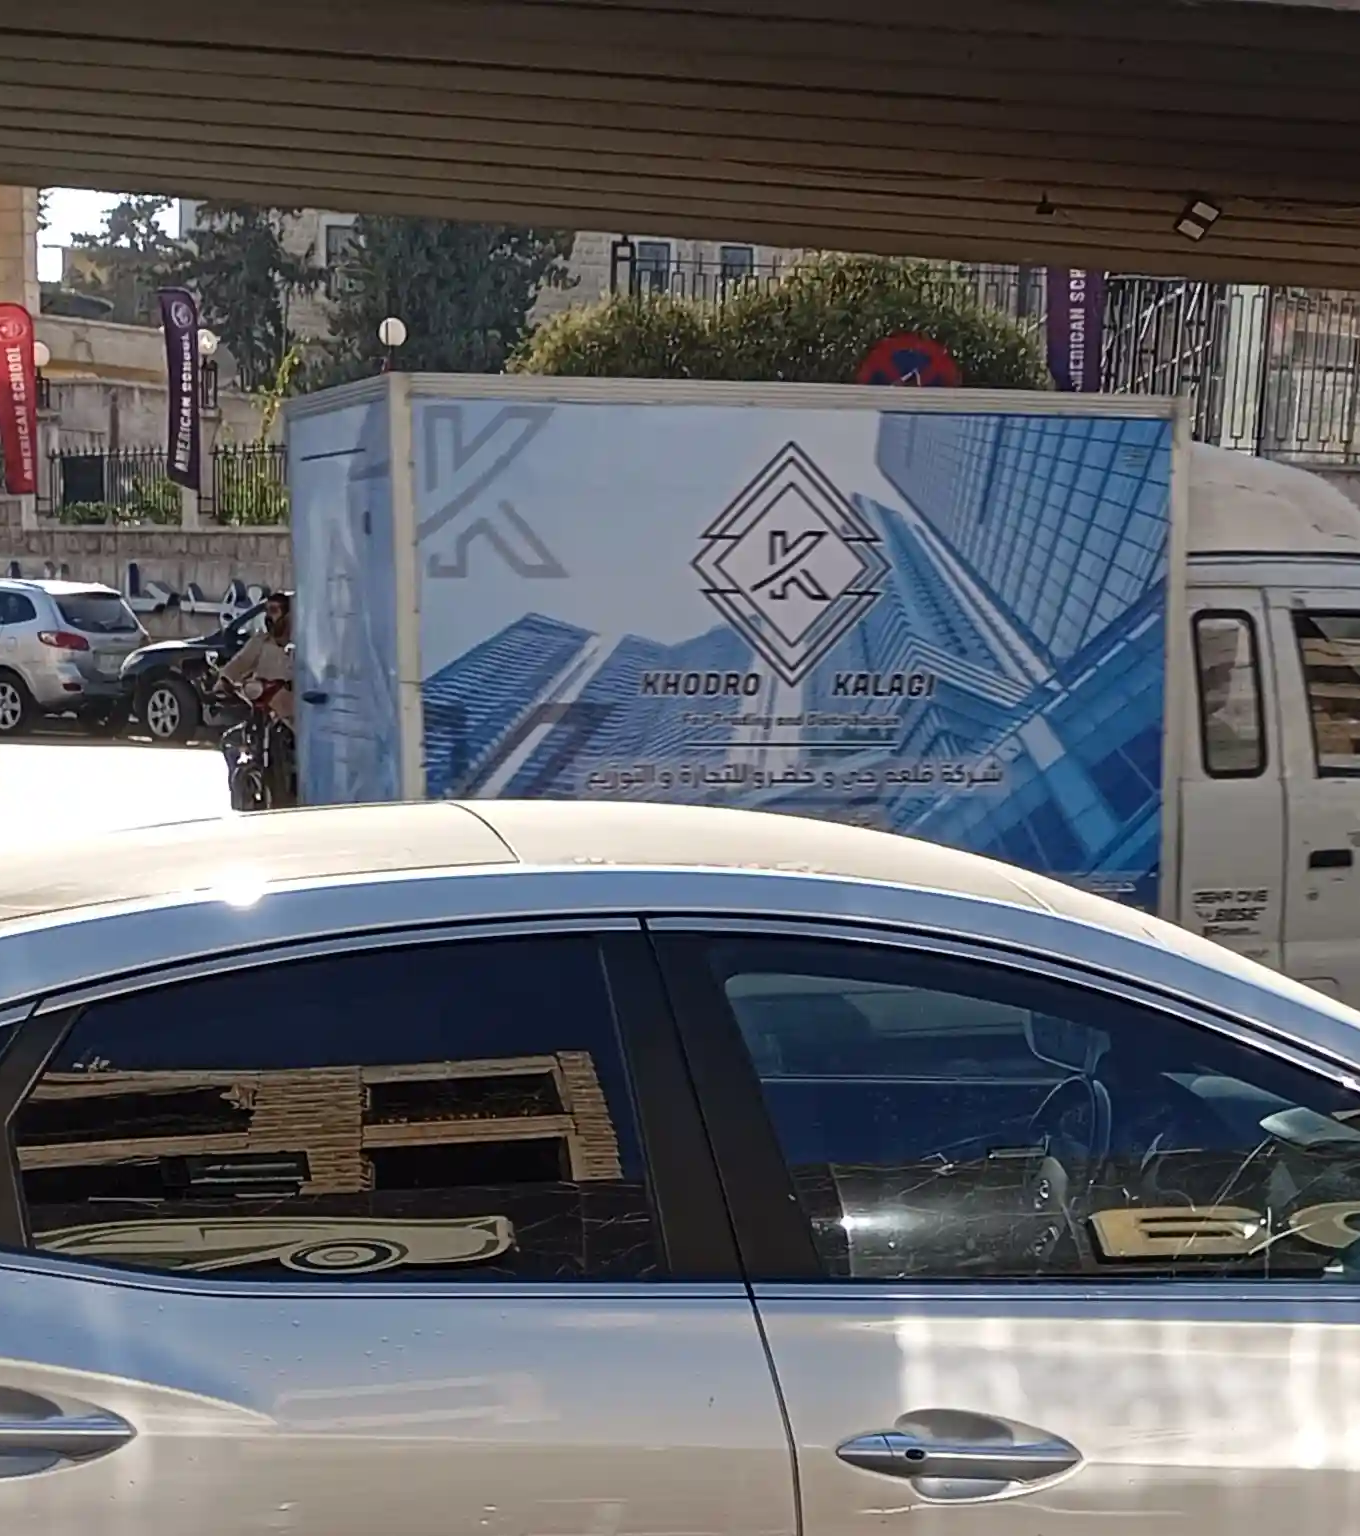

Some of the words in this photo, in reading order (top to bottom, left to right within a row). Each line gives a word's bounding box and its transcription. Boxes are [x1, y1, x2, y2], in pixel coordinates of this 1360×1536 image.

[5, 345, 27, 402] SCHOOL
[641, 673, 760, 696] KHODRO
[832, 673, 936, 697] KALAGI
[776, 714, 804, 727] and
[586, 763, 655, 791] التوزيع
[658, 770, 675, 790] و
[679, 763, 752, 789] للتجارة
[823, 770, 837, 790] و
[941, 764, 1003, 790] شركة
